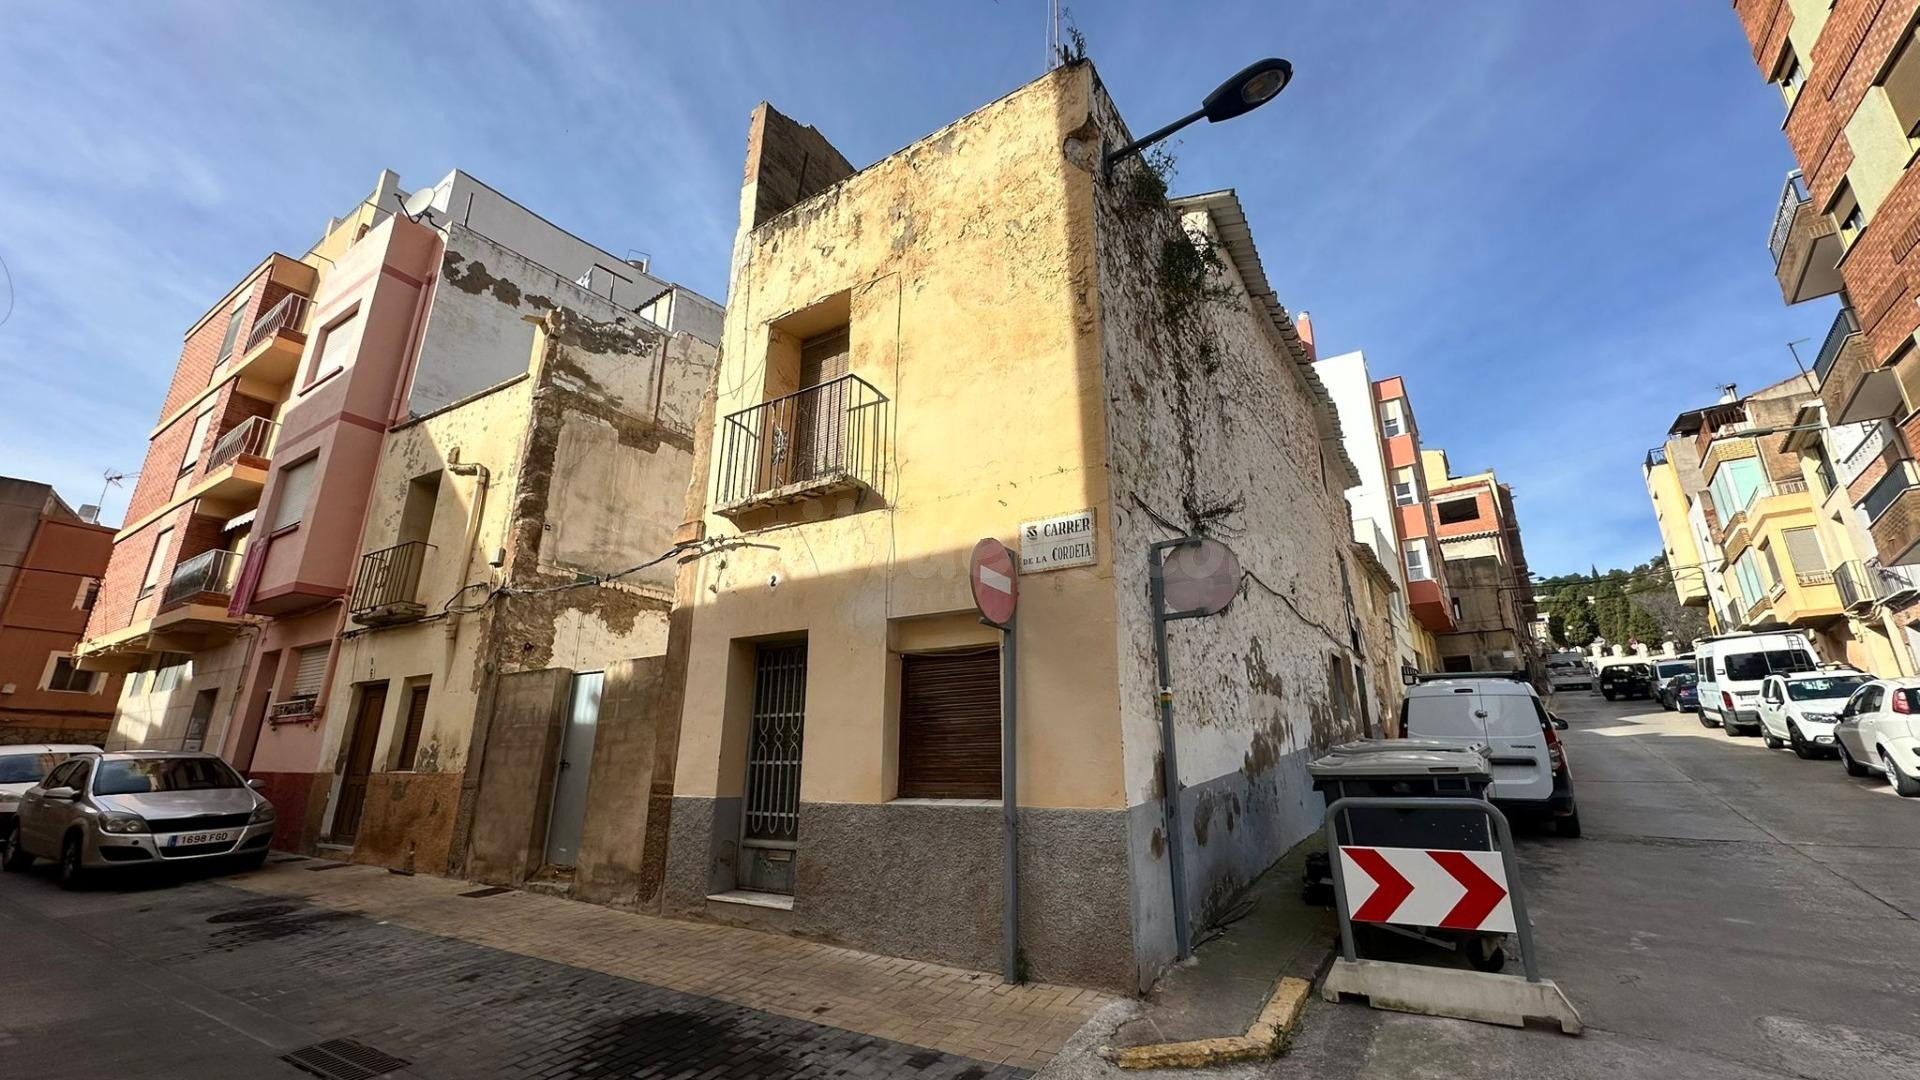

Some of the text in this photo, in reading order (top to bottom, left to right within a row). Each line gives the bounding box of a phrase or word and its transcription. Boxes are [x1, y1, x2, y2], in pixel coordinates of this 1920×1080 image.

[1044, 518, 1090, 537] CARRER
[1023, 543, 1091, 566] DE LA CORDETA
[770, 575, 777, 587] 2
[181, 834, 207, 844] 1698
